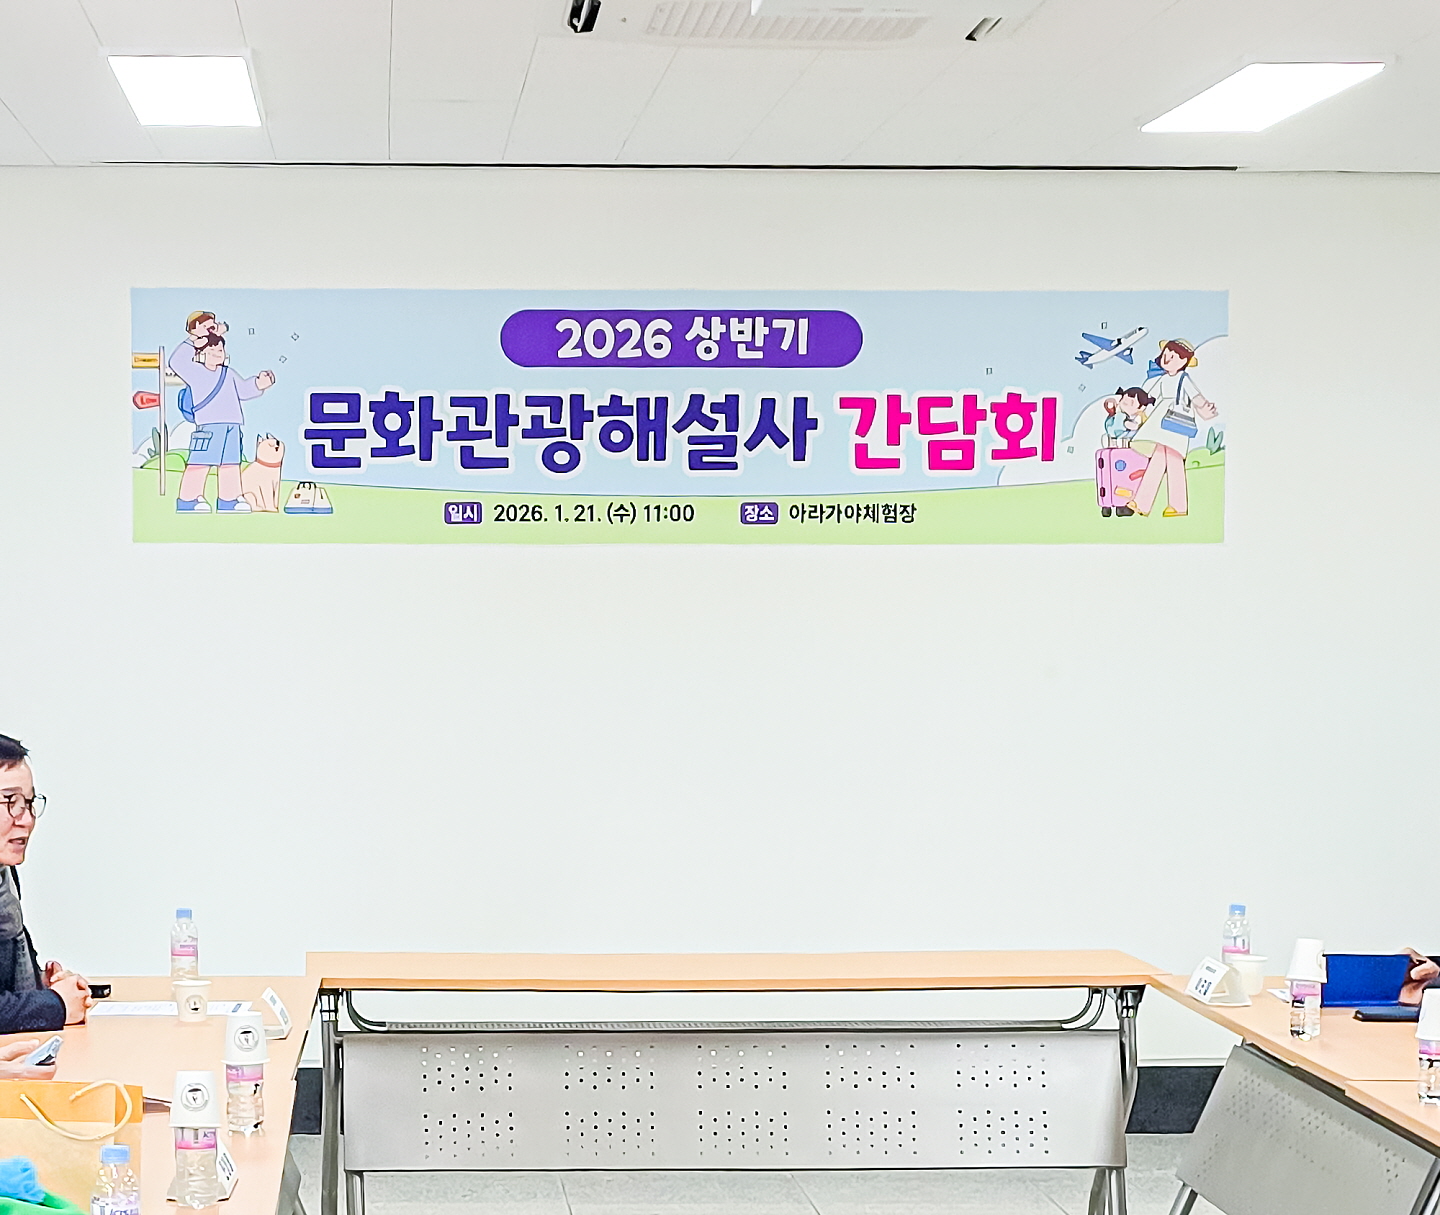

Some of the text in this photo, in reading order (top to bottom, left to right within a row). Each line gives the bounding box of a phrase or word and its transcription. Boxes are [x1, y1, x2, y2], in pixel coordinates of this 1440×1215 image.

[555, 316, 810, 361] 2026 상반기
[304, 390, 1057, 474] 문화관광해설사 간담회
[448, 501, 695, 525] 일시 2026. 1. 21. (수) 11:00
[744, 502, 918, 524] 장소 아라가야체험장
